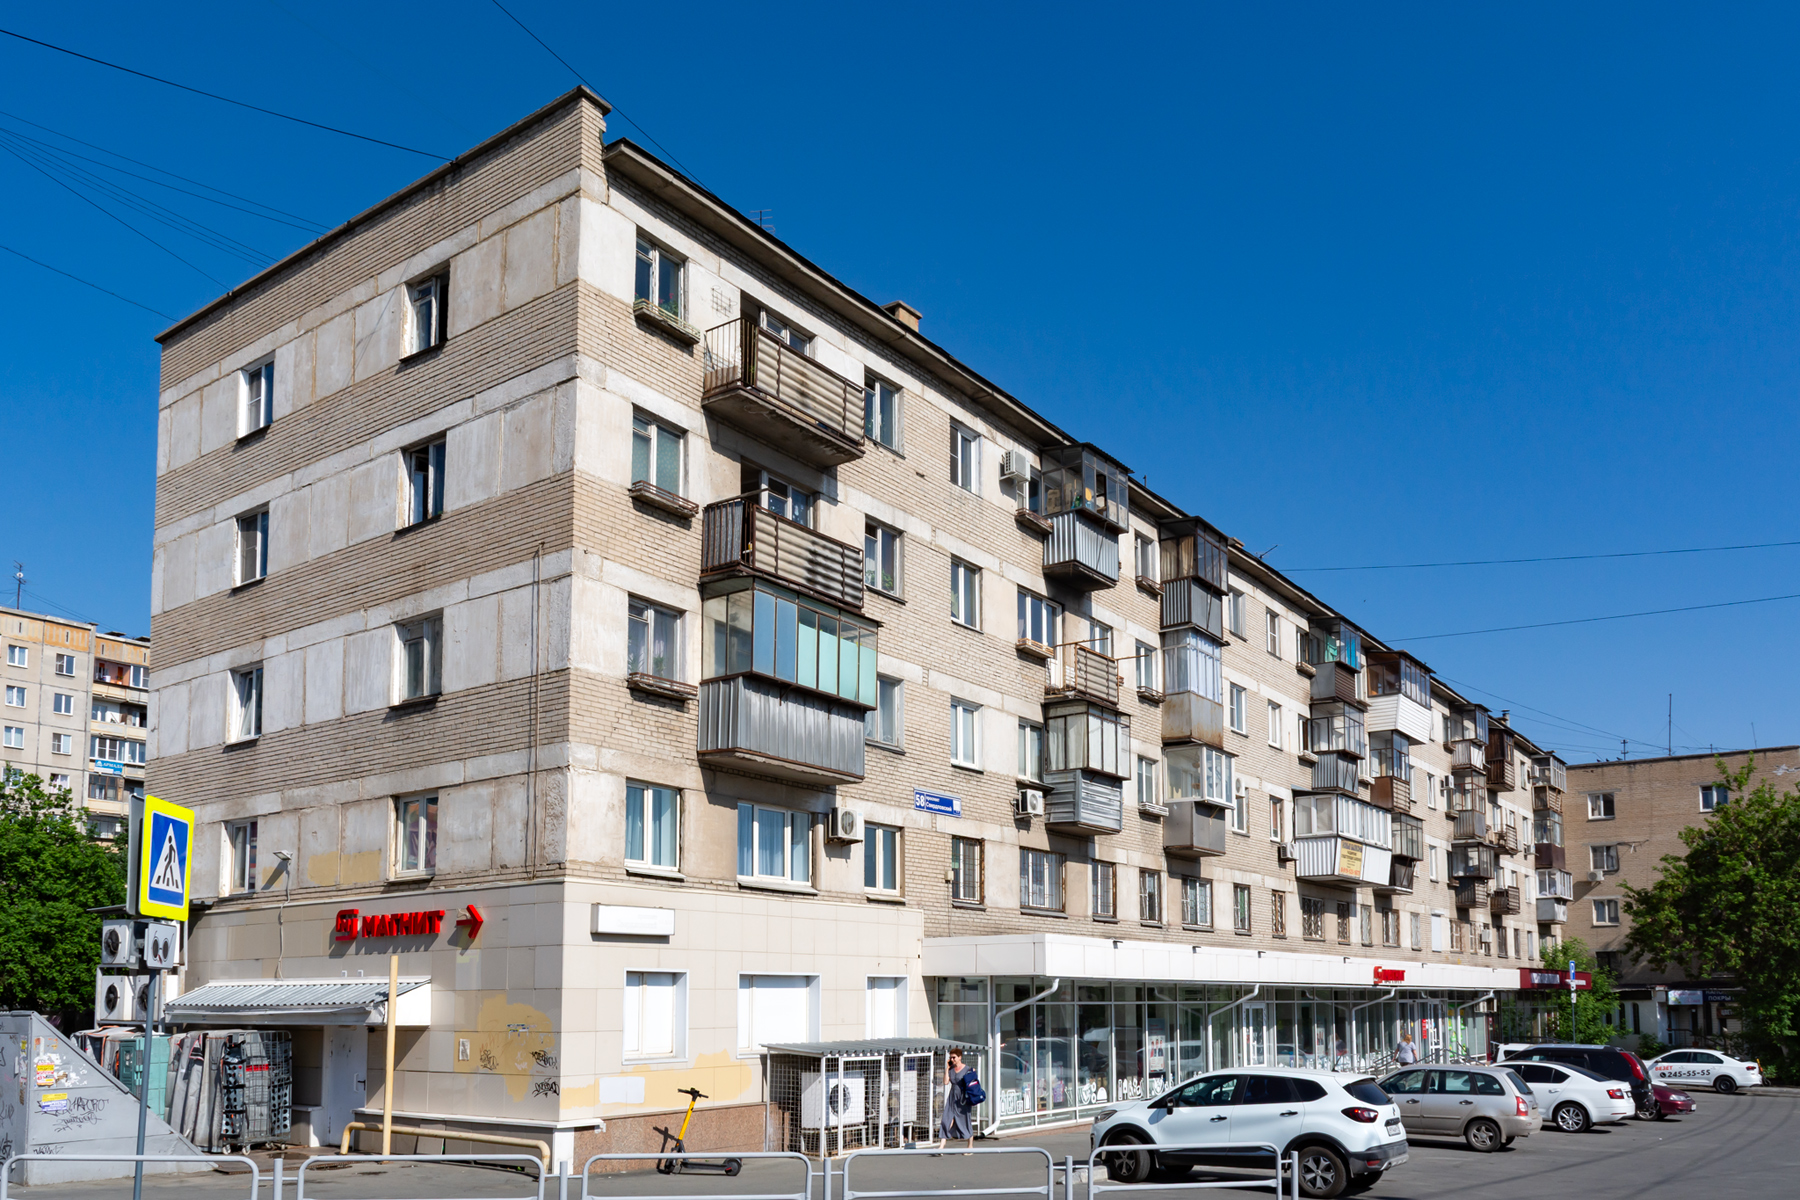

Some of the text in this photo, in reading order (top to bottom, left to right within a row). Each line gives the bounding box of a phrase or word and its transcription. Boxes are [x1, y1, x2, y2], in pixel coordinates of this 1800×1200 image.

[916, 794, 924, 807] 58
[362, 910, 445, 938] МАГНИТ
[1668, 1069, 1711, 1078] 245-55-55
